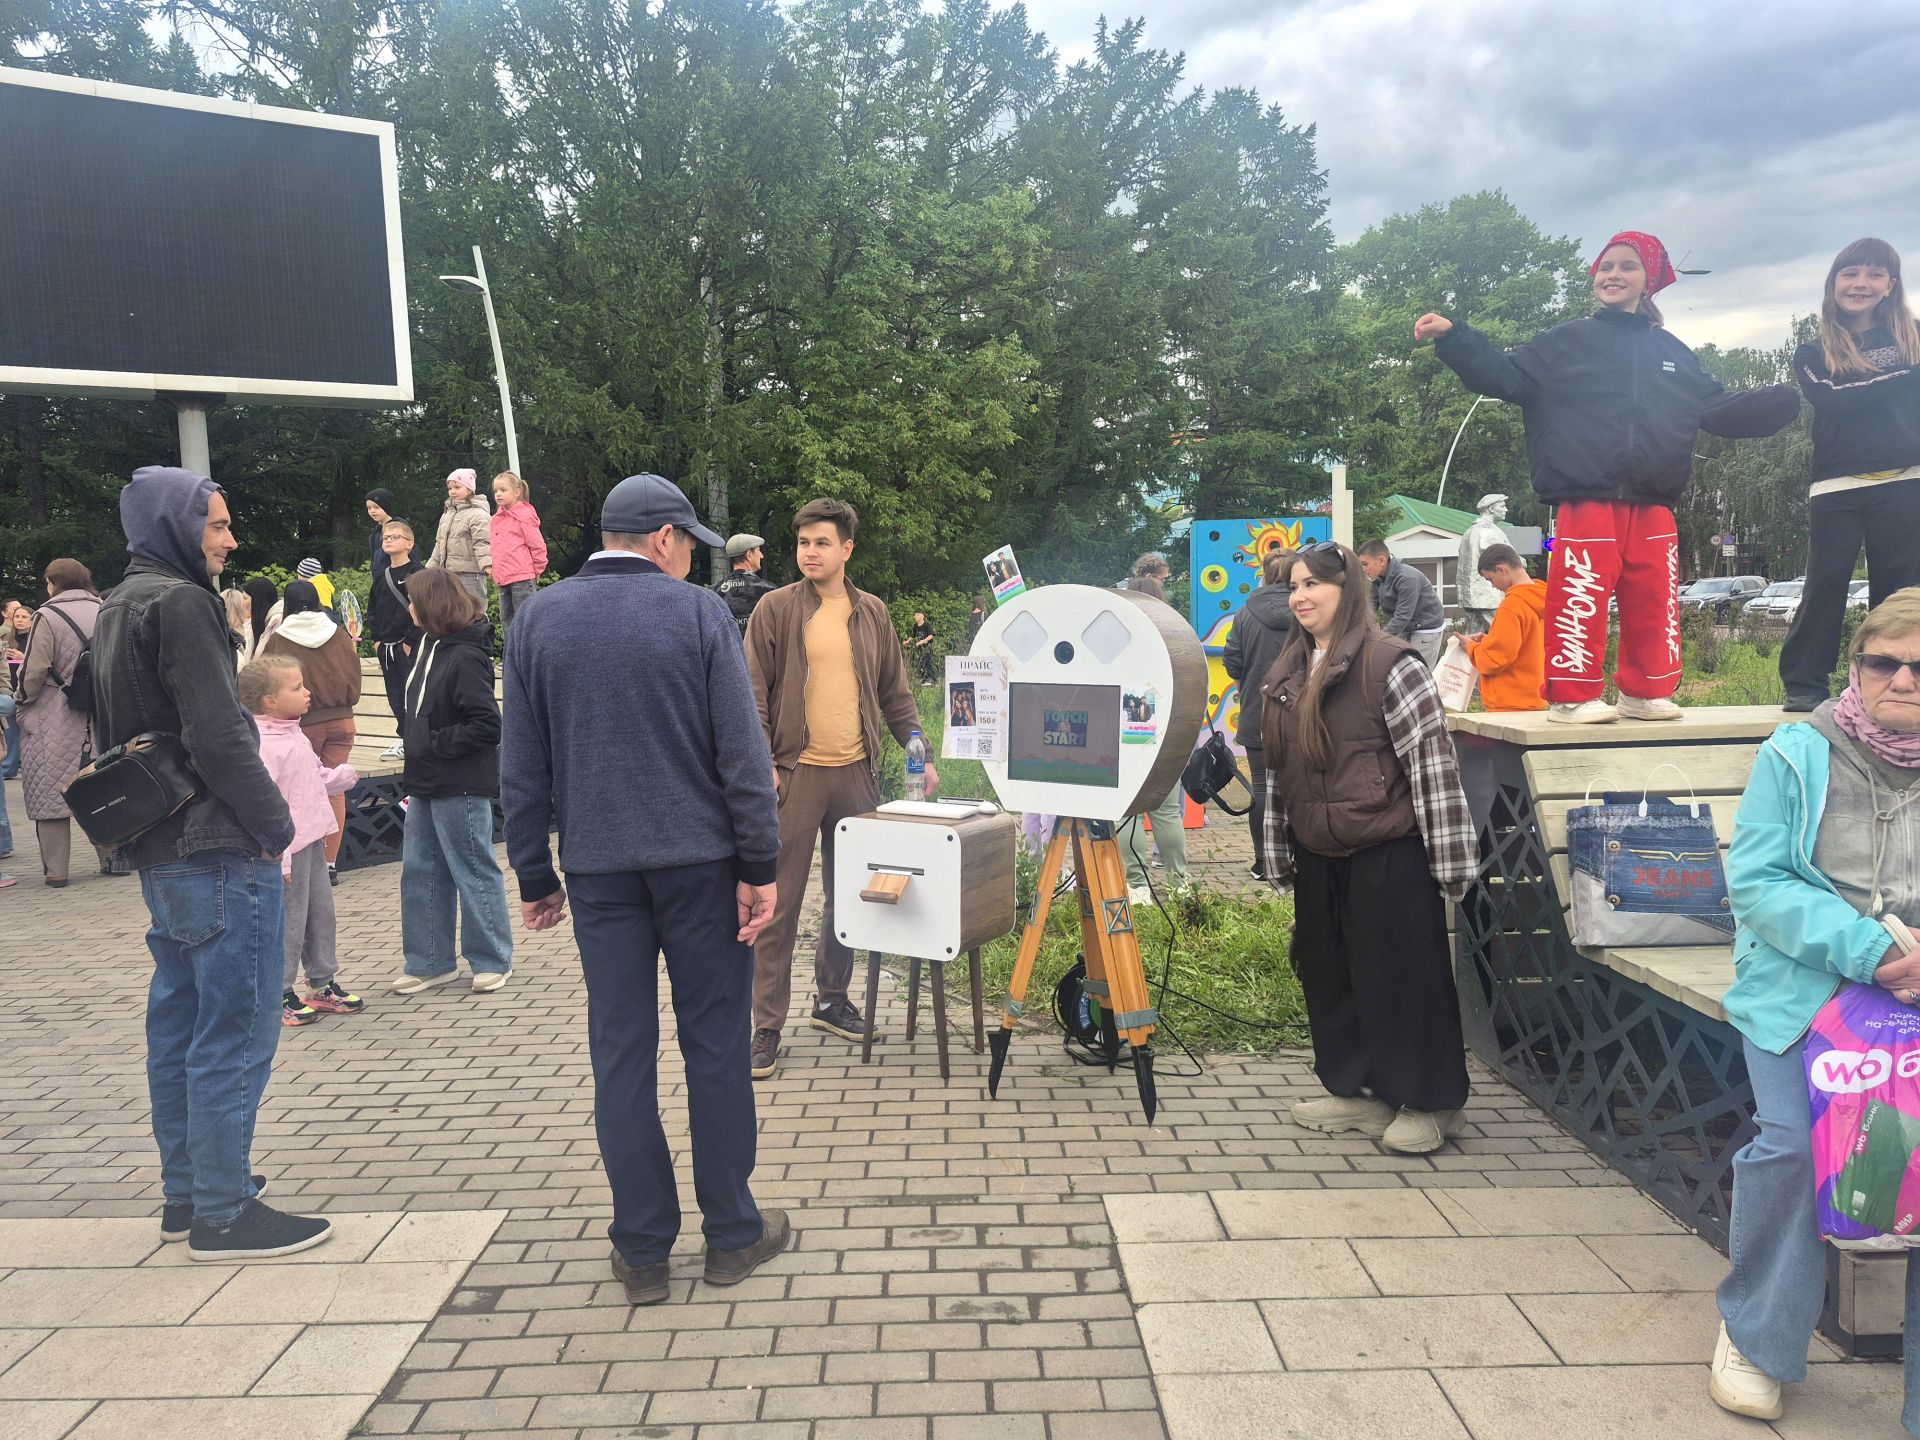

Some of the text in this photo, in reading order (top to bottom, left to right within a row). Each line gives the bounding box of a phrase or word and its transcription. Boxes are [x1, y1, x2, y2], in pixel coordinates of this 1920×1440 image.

[1043, 709, 1088, 724] TOUCH
[1631, 866, 1713, 887] JEANS
[1894, 1213, 1914, 1232] МИР
